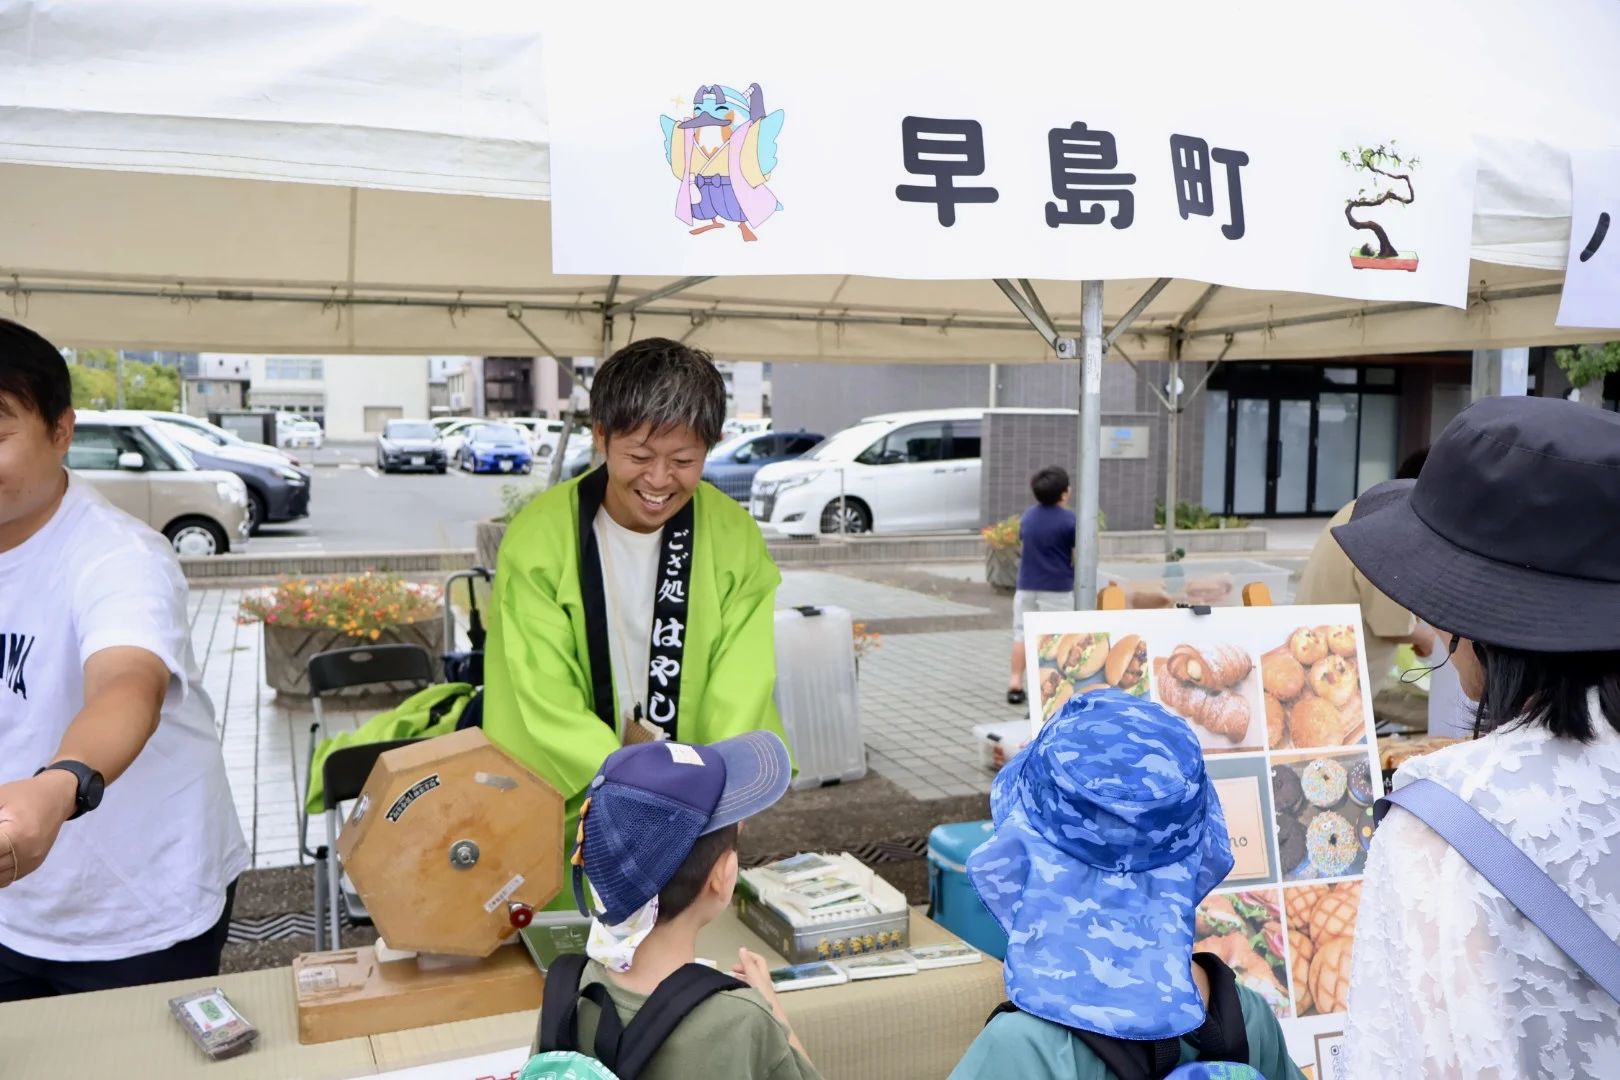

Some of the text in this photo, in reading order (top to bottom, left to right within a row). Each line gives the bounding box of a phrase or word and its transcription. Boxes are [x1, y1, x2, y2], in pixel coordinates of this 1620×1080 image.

[895, 115, 1250, 241] 早島町
[649, 617, 684, 740] はやし
